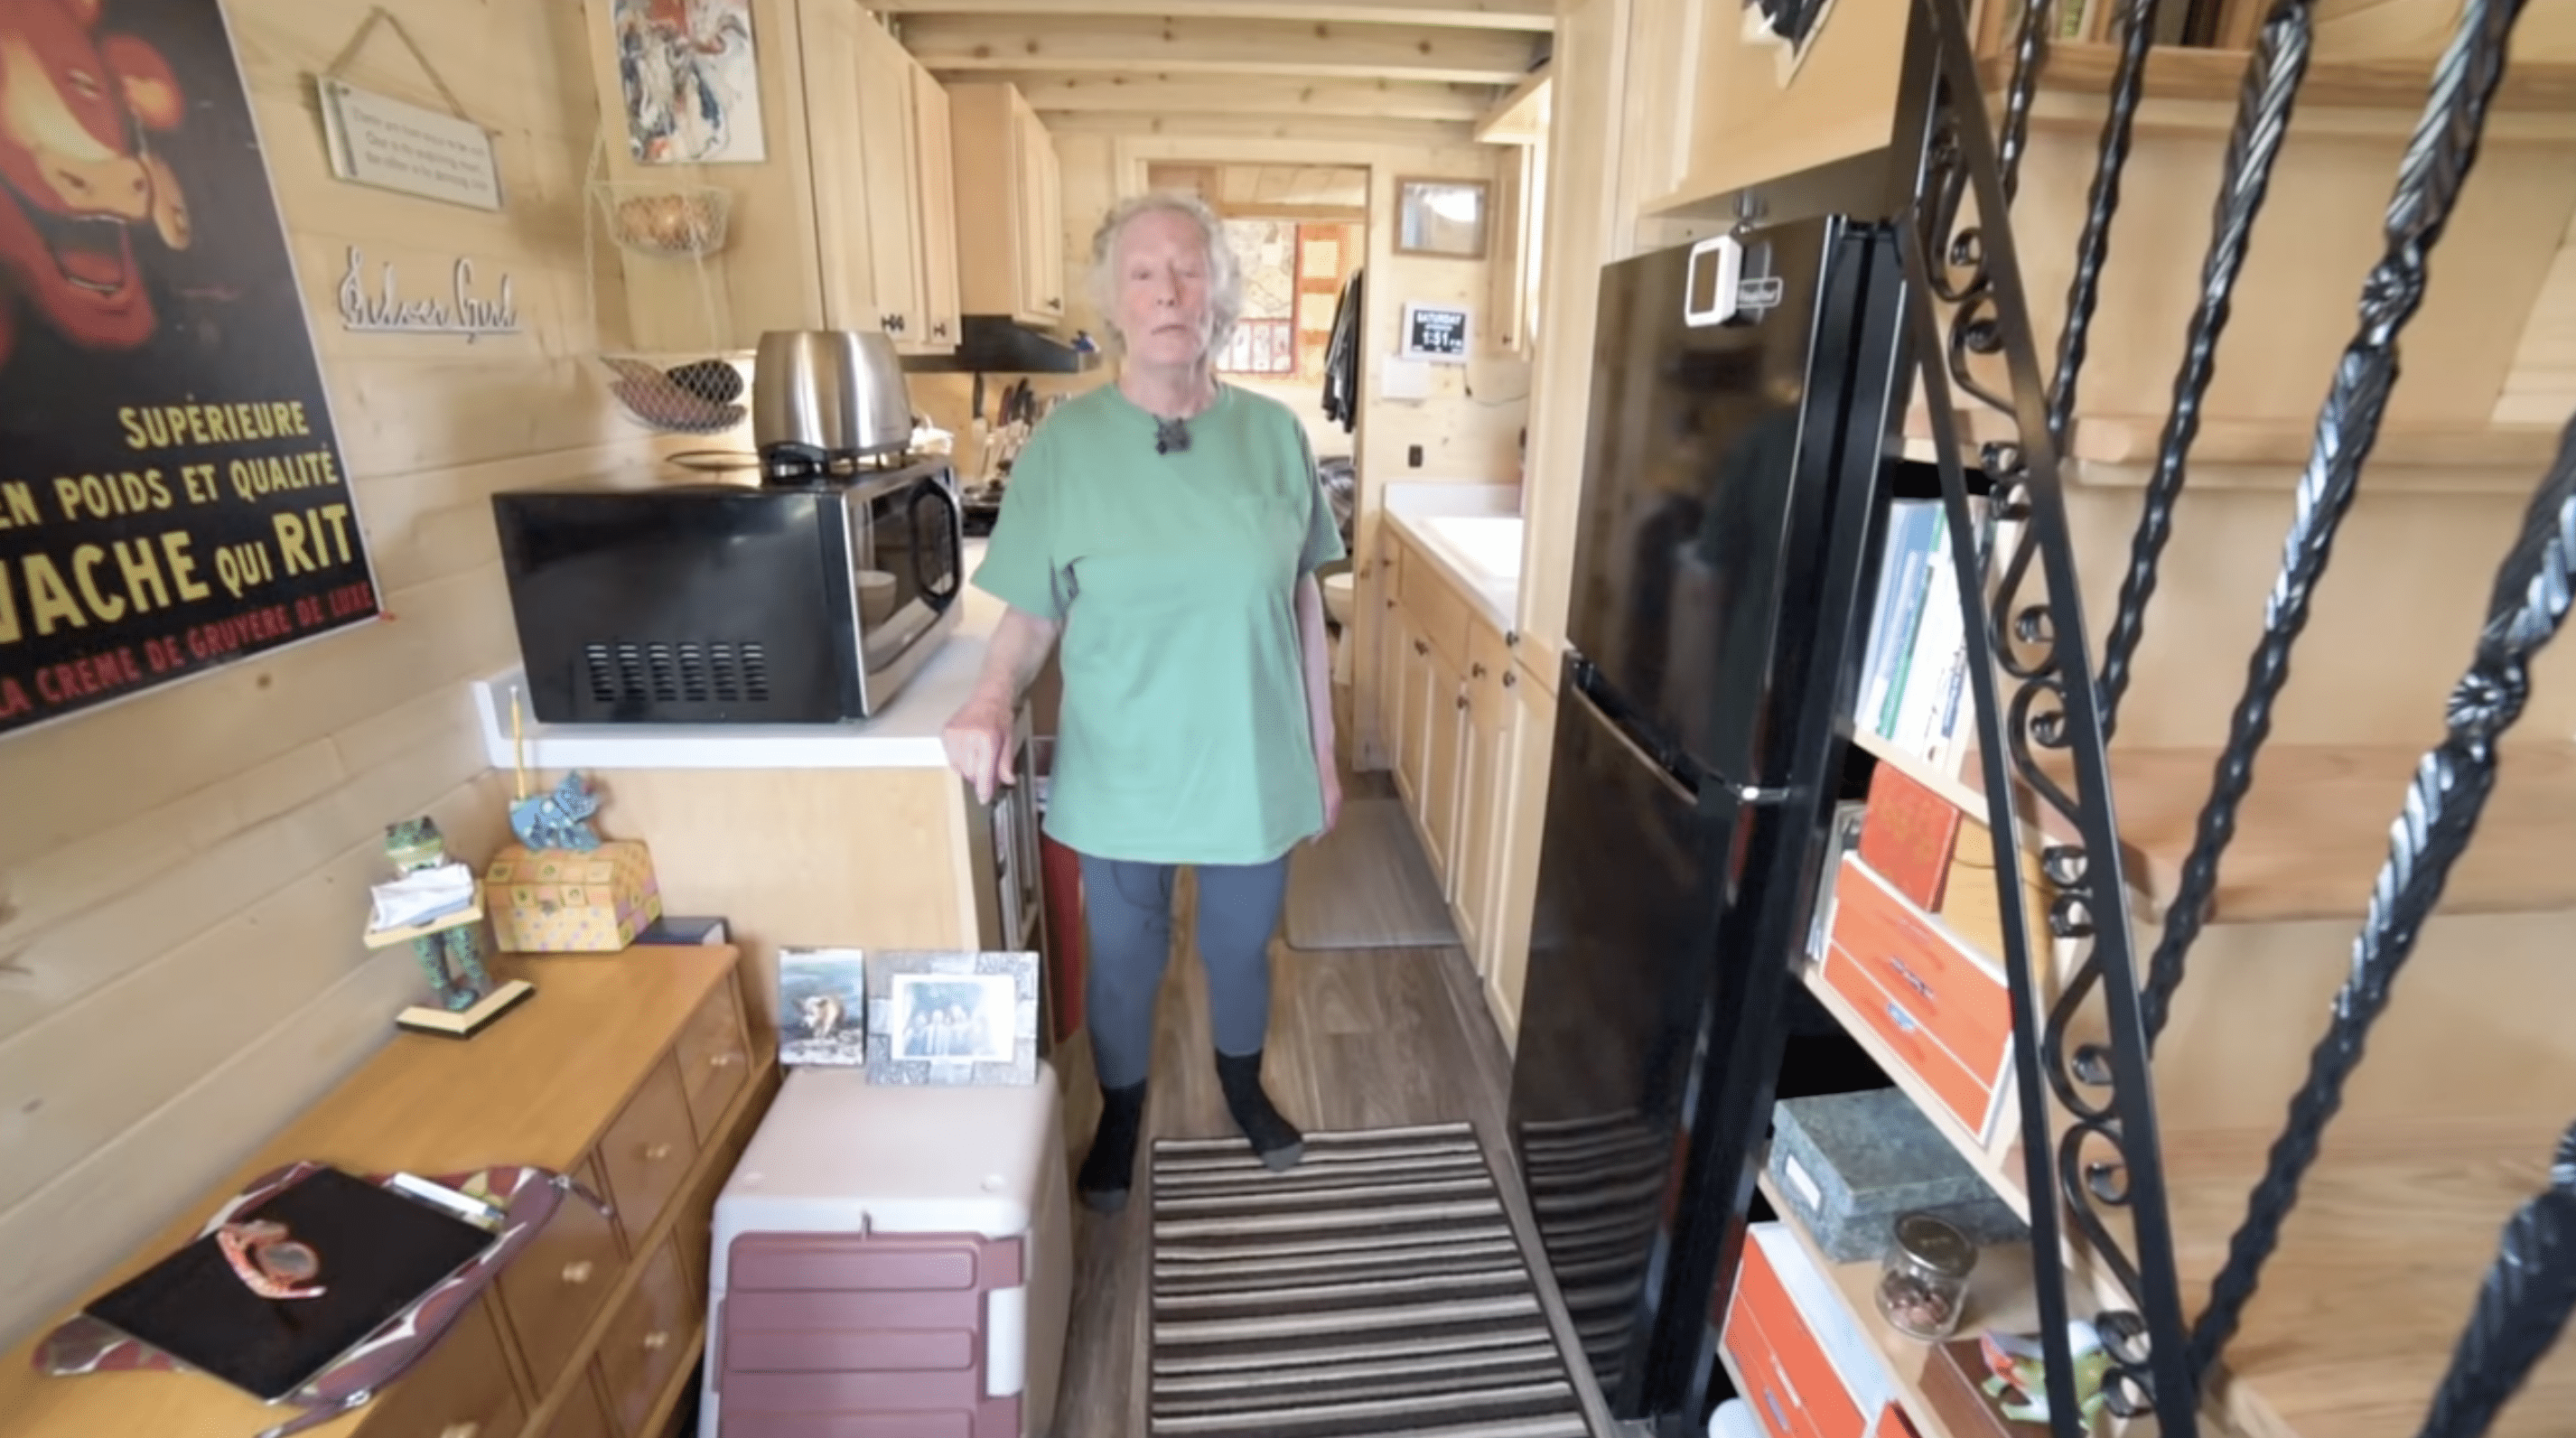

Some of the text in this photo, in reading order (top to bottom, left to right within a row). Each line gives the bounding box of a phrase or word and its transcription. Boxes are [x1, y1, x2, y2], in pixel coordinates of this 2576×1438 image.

[117, 394, 311, 449] SUPÉRIEURE
[53, 468, 173, 520] POIDS
[181, 463, 219, 504] ET
[229, 444, 340, 502] QUALITÉ
[215, 543, 273, 598] QUI
[273, 503, 352, 576] RIT
[145, 635, 187, 673] DE
[294, 595, 325, 627] DE
[328, 581, 374, 619] LUXE
